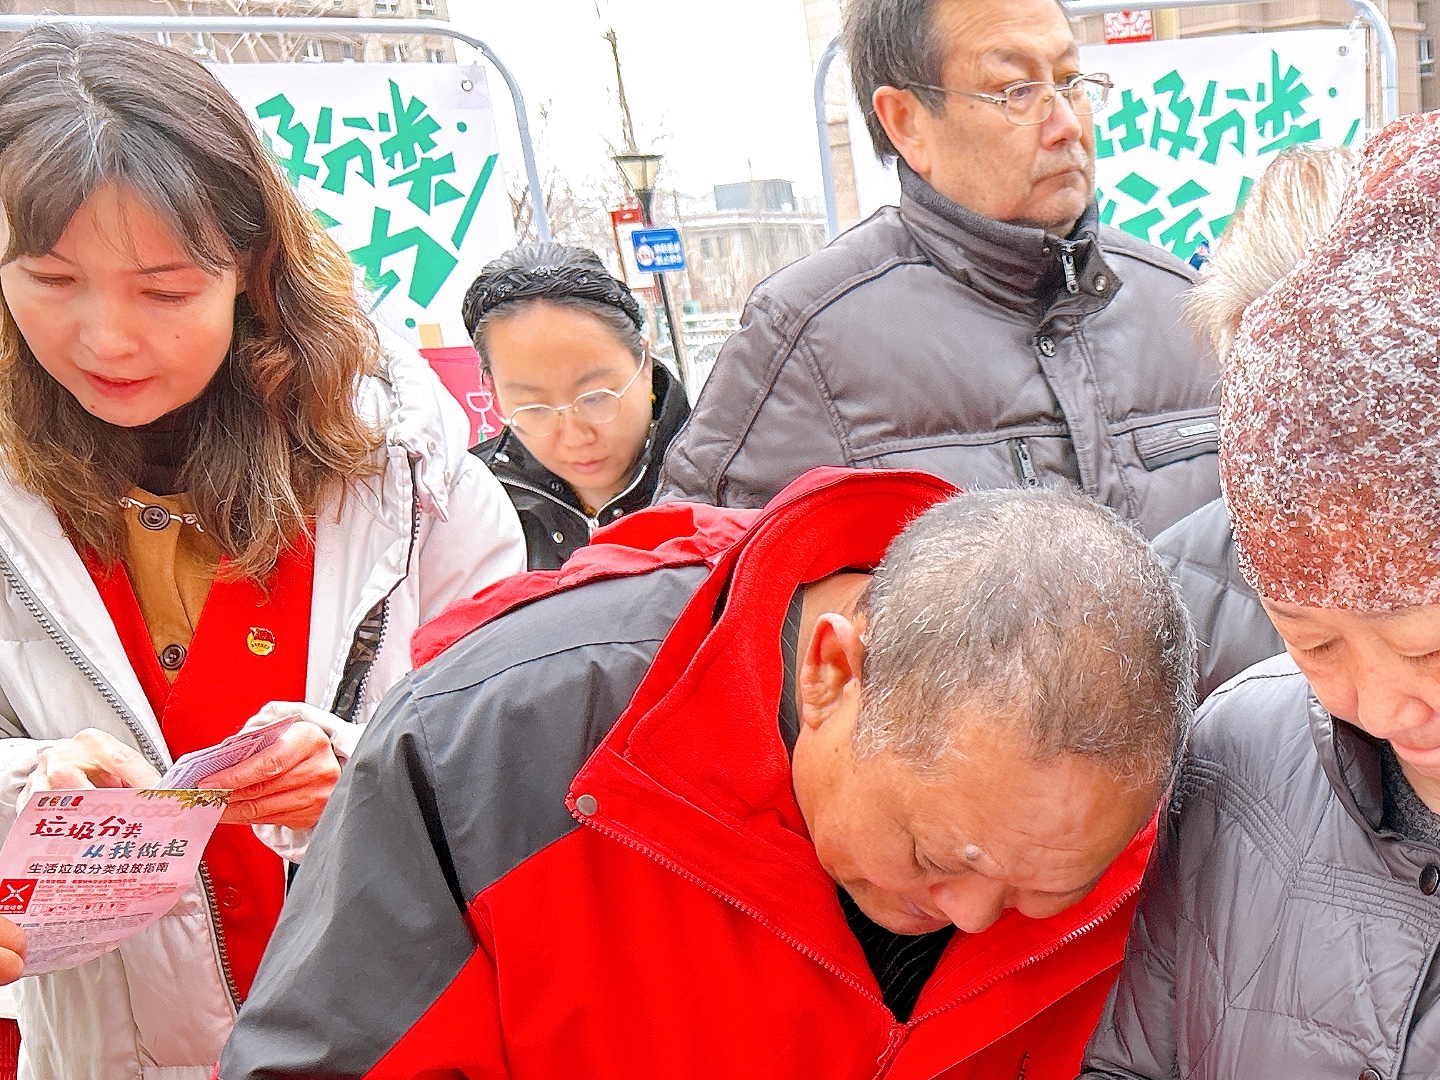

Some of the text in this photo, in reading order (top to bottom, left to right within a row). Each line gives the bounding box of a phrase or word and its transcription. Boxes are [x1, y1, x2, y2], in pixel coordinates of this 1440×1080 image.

[1094, 49, 1321, 165] 圾分类
[30, 815, 144, 840] 垃圾分类
[82, 838, 189, 860] 从我做起
[27, 862, 170, 875] 生活垃圾分类投放指南
